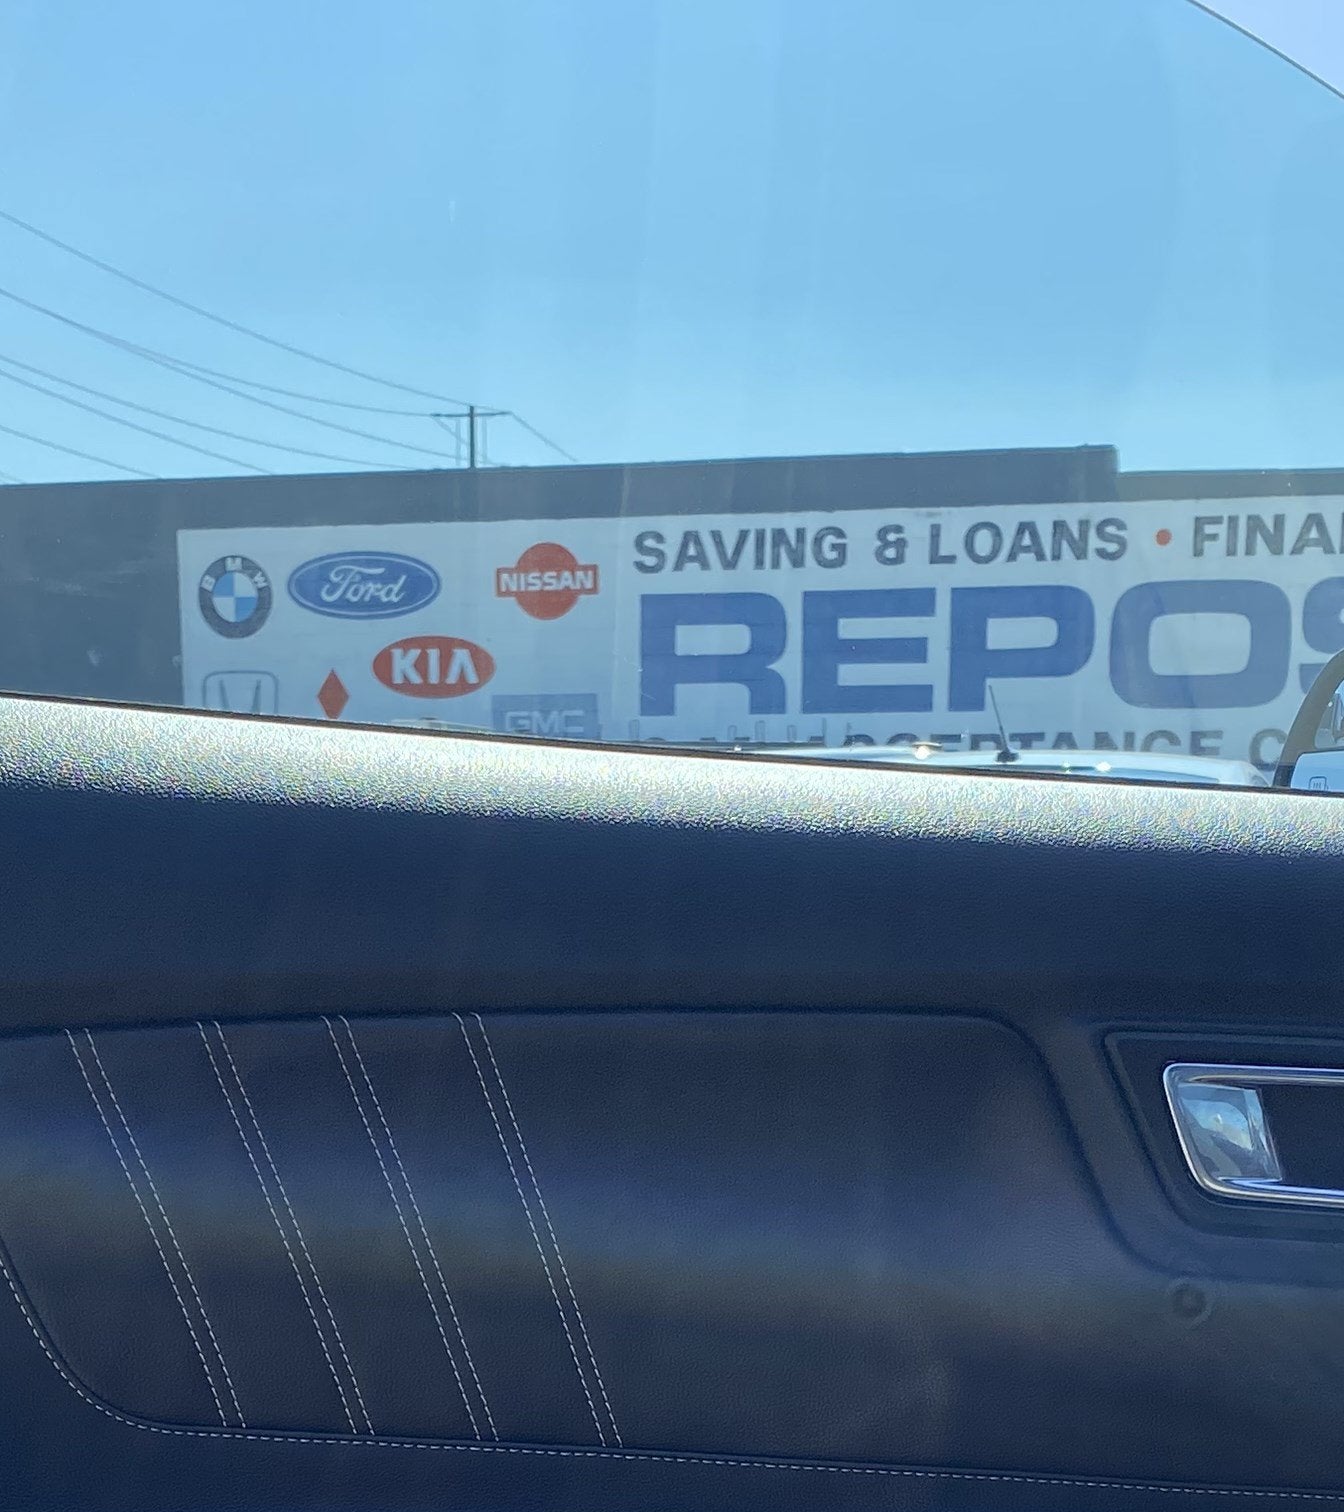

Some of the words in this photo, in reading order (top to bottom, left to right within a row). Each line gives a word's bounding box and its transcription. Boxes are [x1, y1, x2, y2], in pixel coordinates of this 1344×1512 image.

[633, 526, 849, 574] SAVING
[874, 524, 909, 566] &
[929, 517, 1129, 566] LOANS
[320, 565, 408, 603] Ford
[499, 567, 596, 594] NISSAN
[389, 648, 479, 686] KIA
